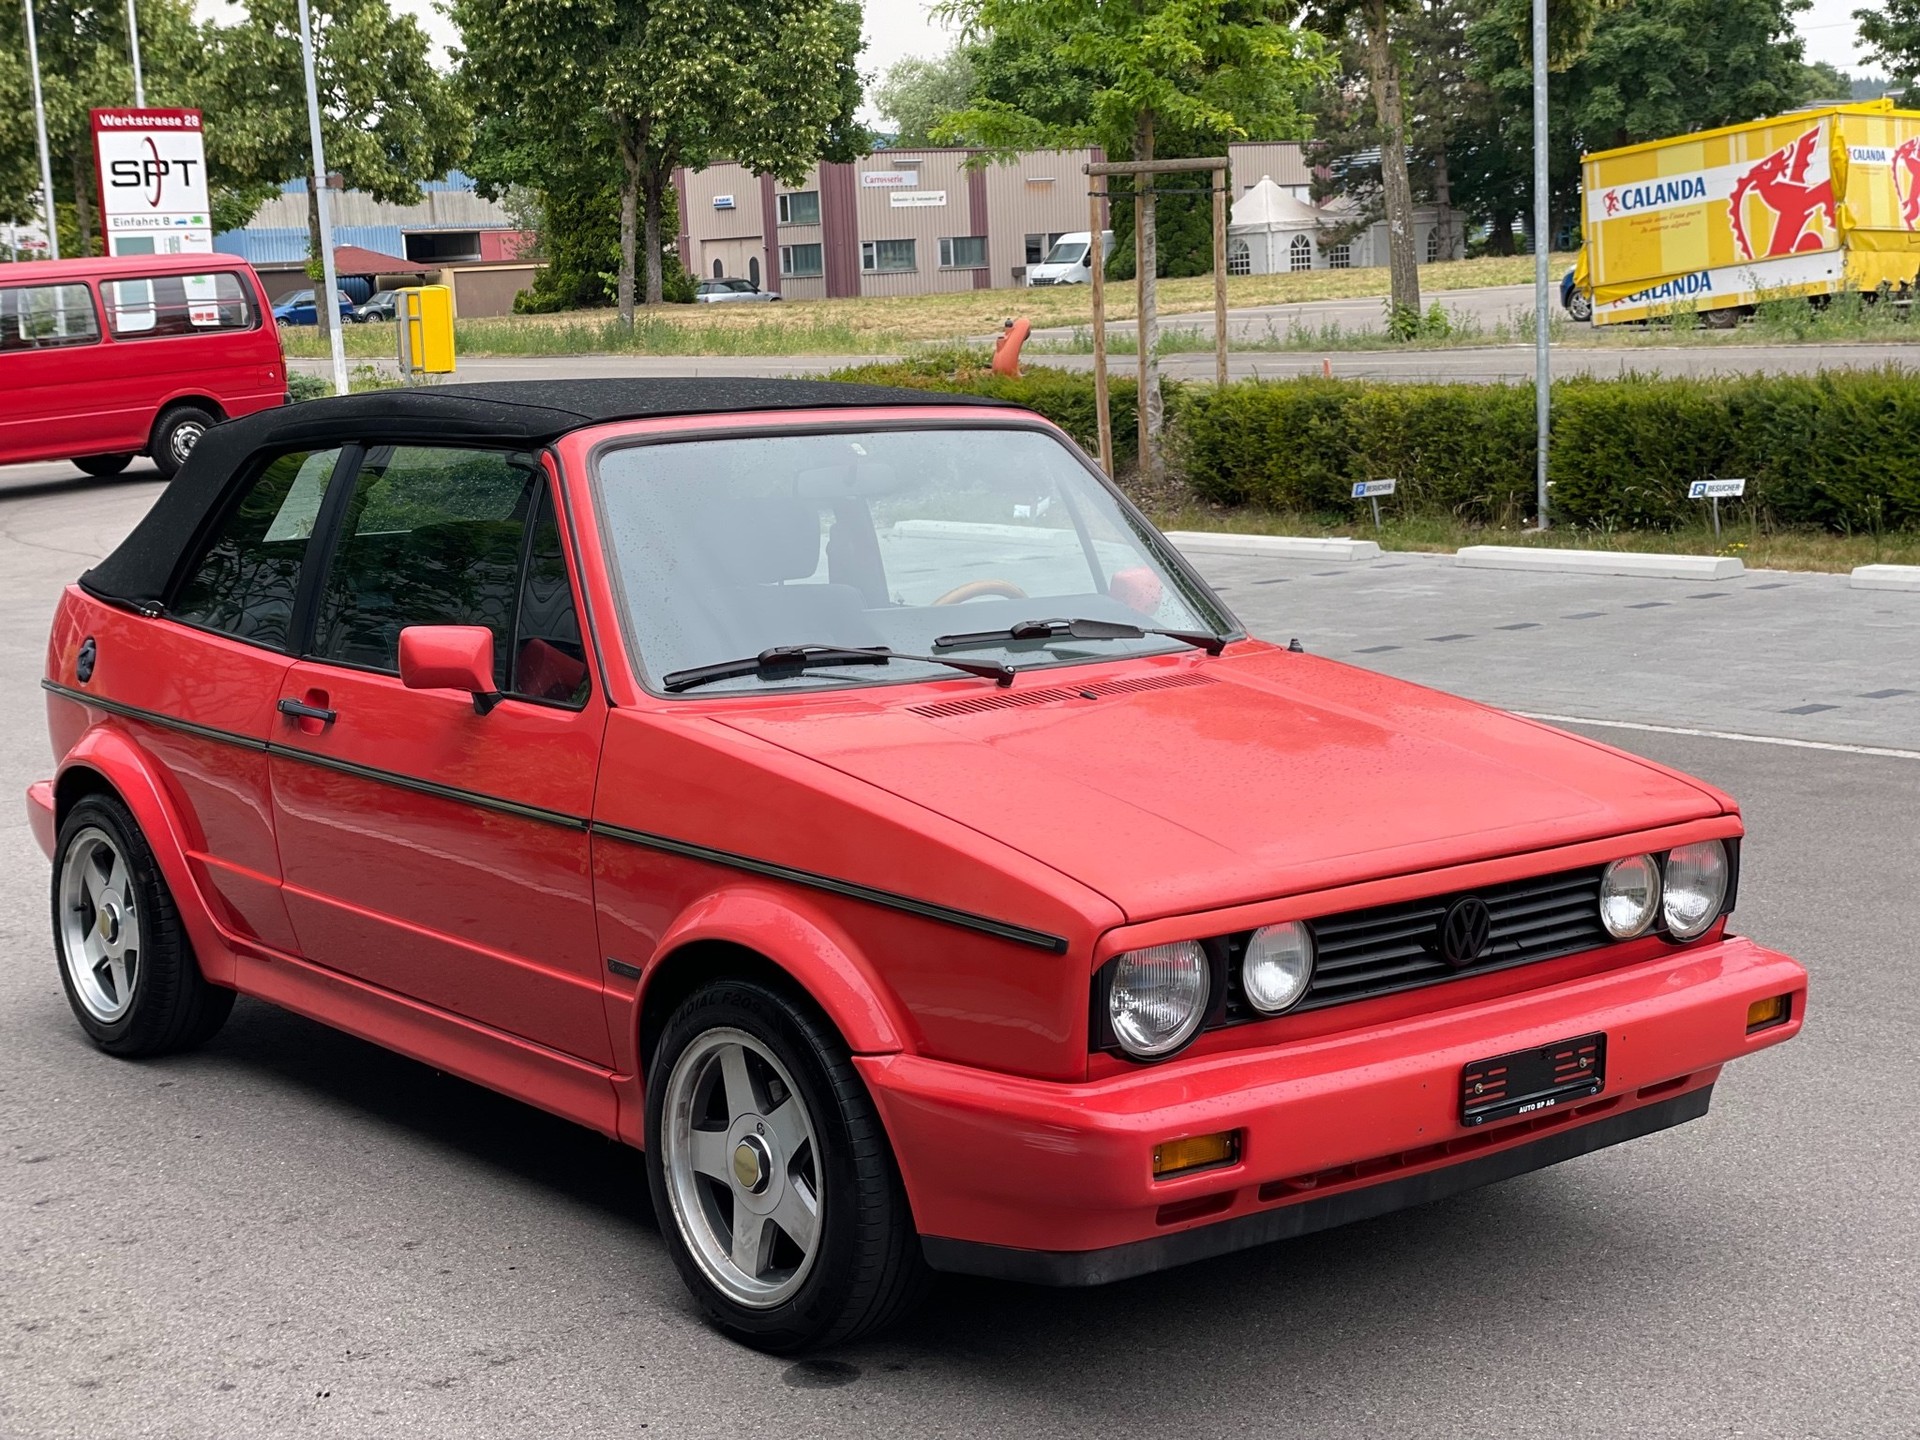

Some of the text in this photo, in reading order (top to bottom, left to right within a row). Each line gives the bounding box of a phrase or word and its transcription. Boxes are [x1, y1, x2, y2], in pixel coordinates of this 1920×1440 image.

[99, 114, 200, 127] Werkstrasse 28
[1853, 149, 1886, 161] CALANDA
[111, 160, 197, 187] SPT
[864, 174, 904, 184] Carrosserie
[1621, 176, 1707, 210] CALANDA
[113, 216, 160, 227] Einfahrt
[1708, 484, 1740, 492] BESUCHER
[1519, 1103, 1536, 1113] AUTO
[1546, 1098, 1555, 1107] AG
